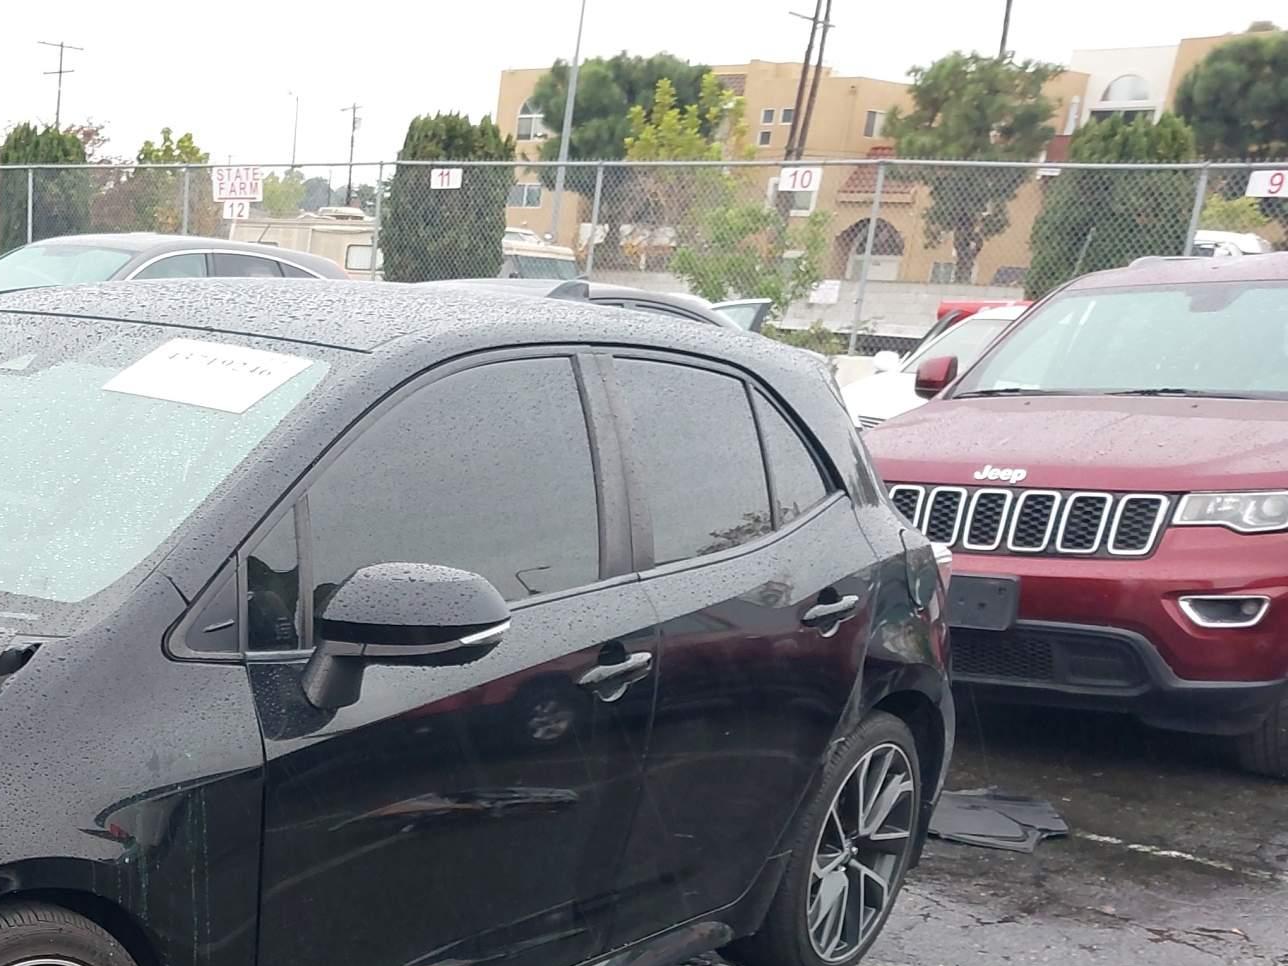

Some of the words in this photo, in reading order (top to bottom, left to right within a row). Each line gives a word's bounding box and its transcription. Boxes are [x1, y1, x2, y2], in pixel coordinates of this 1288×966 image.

[216, 168, 260, 181] STATE
[438, 170, 450, 187] 11
[789, 169, 813, 189] 10
[1268, 172, 1285, 194] 9
[218, 182, 258, 195] FARM
[229, 202, 245, 218] 12
[973, 464, 1027, 484] Jeep
